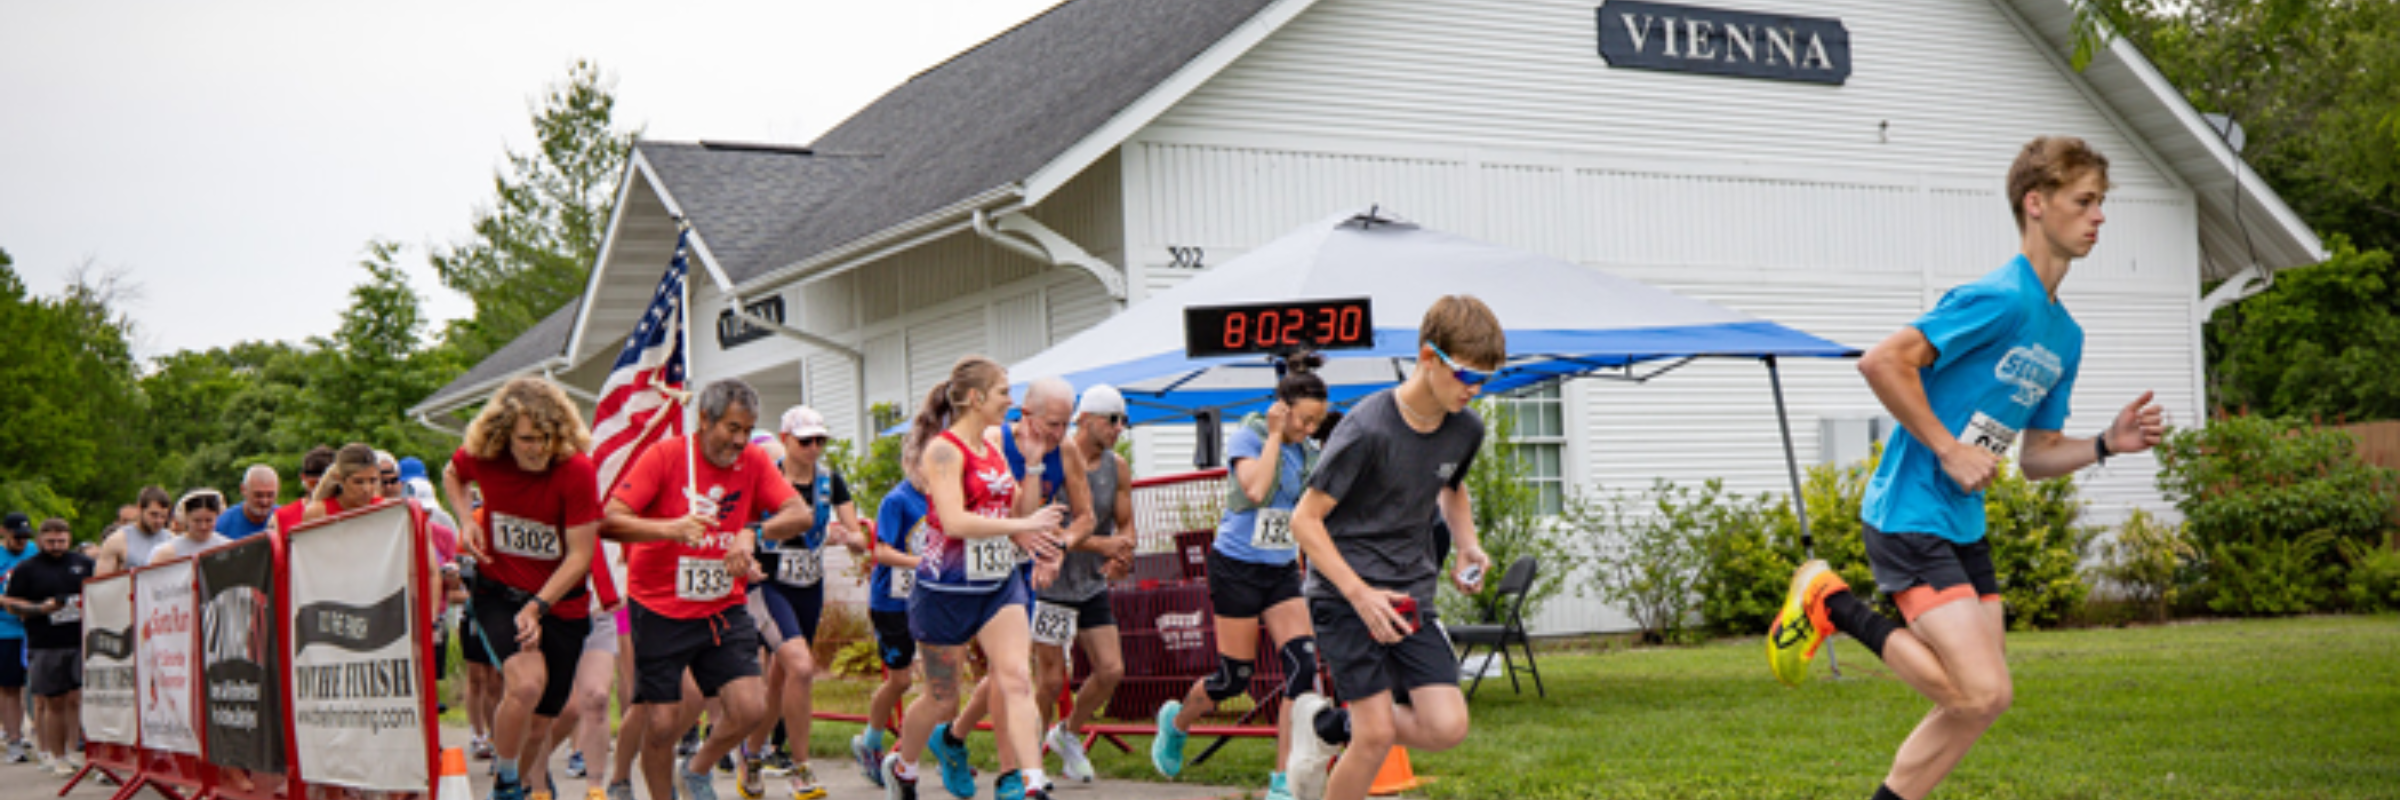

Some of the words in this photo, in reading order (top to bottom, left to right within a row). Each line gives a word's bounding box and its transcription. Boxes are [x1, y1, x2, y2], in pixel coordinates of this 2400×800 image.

[1621, 13, 1832, 69] VIENNA
[1167, 246, 1204, 268] 302
[1223, 304, 1362, 348] 8:02:30
[500, 525, 556, 553] 1302
[1261, 516, 1292, 543] 132
[1035, 610, 1069, 639] 623
[344, 658, 412, 698] FINISH
